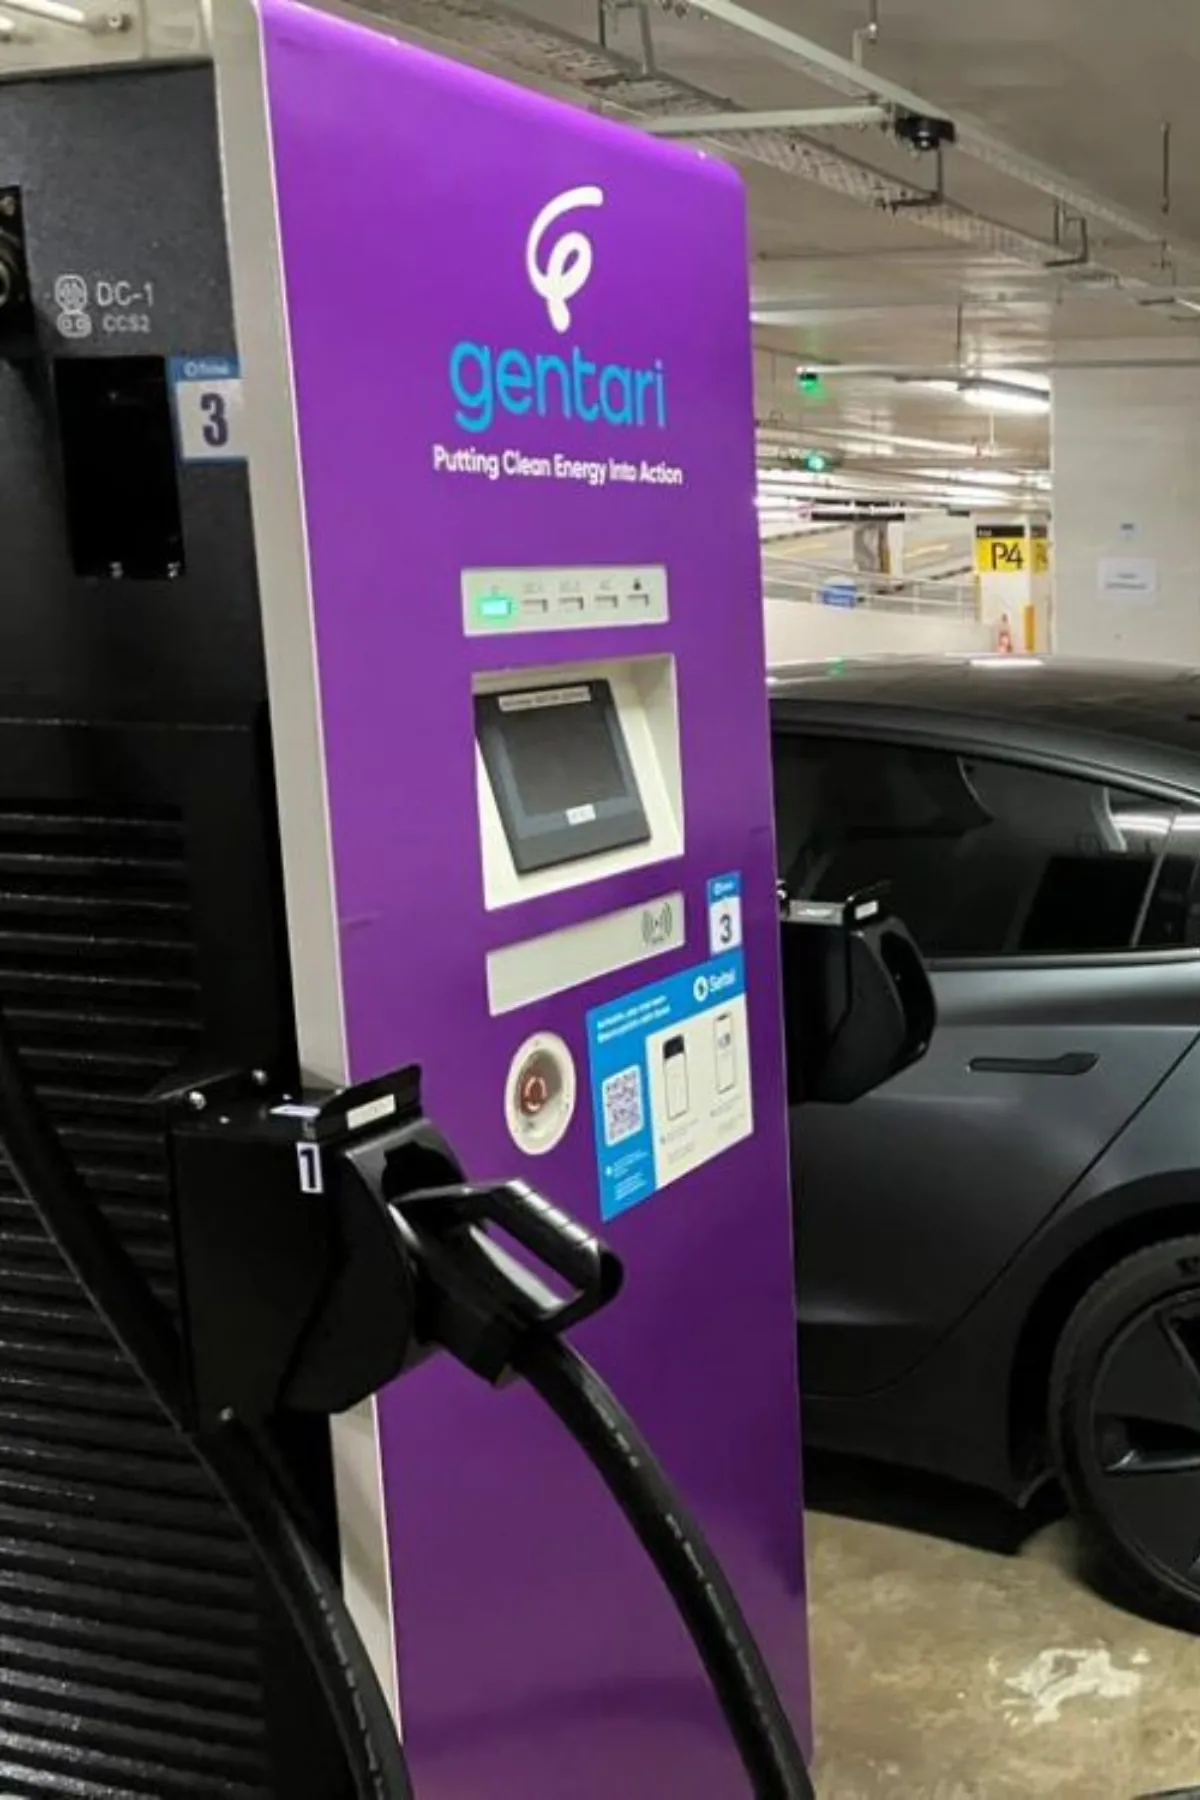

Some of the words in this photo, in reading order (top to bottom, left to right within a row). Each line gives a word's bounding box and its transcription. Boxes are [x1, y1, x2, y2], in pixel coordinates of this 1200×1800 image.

[97, 281, 154, 307] DC-1
[103, 314, 151, 333] CCS2
[450, 341, 666, 433] gentari
[200, 393, 228, 447] 3
[432, 443, 499, 480] Putting
[502, 449, 551, 477] Clean
[553, 453, 606, 486] Energy
[608, 457, 636, 482] Into
[639, 460, 683, 486] Action
[991, 541, 1023, 571] P4
[719, 914, 732, 944] 3
[299, 1146, 316, 1190] 1
